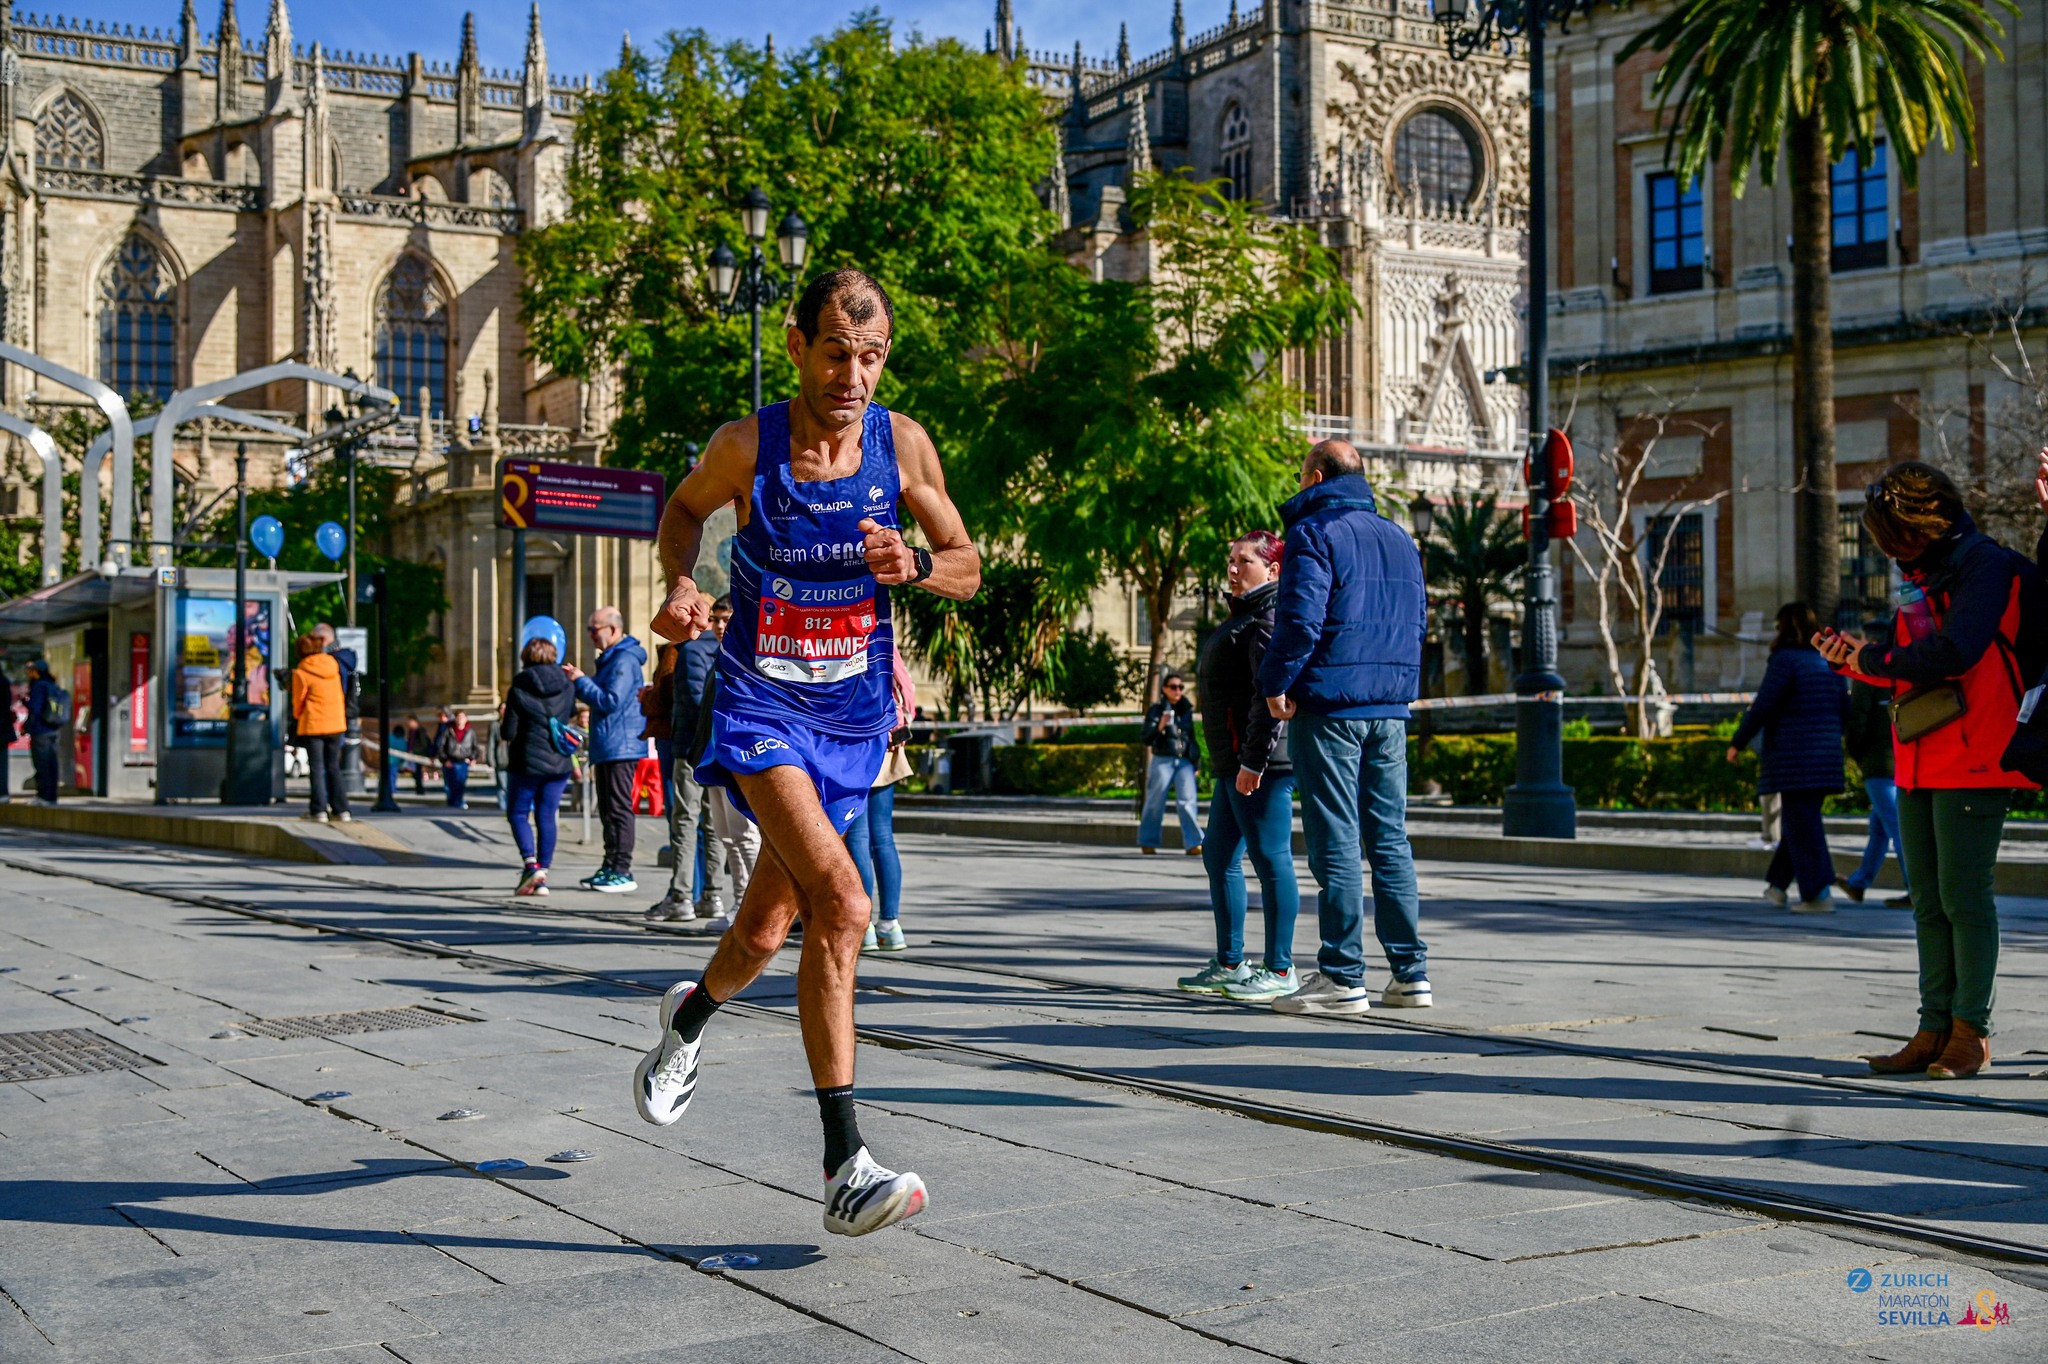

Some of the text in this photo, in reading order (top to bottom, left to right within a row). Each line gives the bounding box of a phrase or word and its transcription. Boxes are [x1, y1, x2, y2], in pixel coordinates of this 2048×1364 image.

[769, 544, 807, 562] team
[800, 584, 864, 601] ZURICH
[804, 617, 832, 630] 812
[740, 738, 790, 762] INEOS
